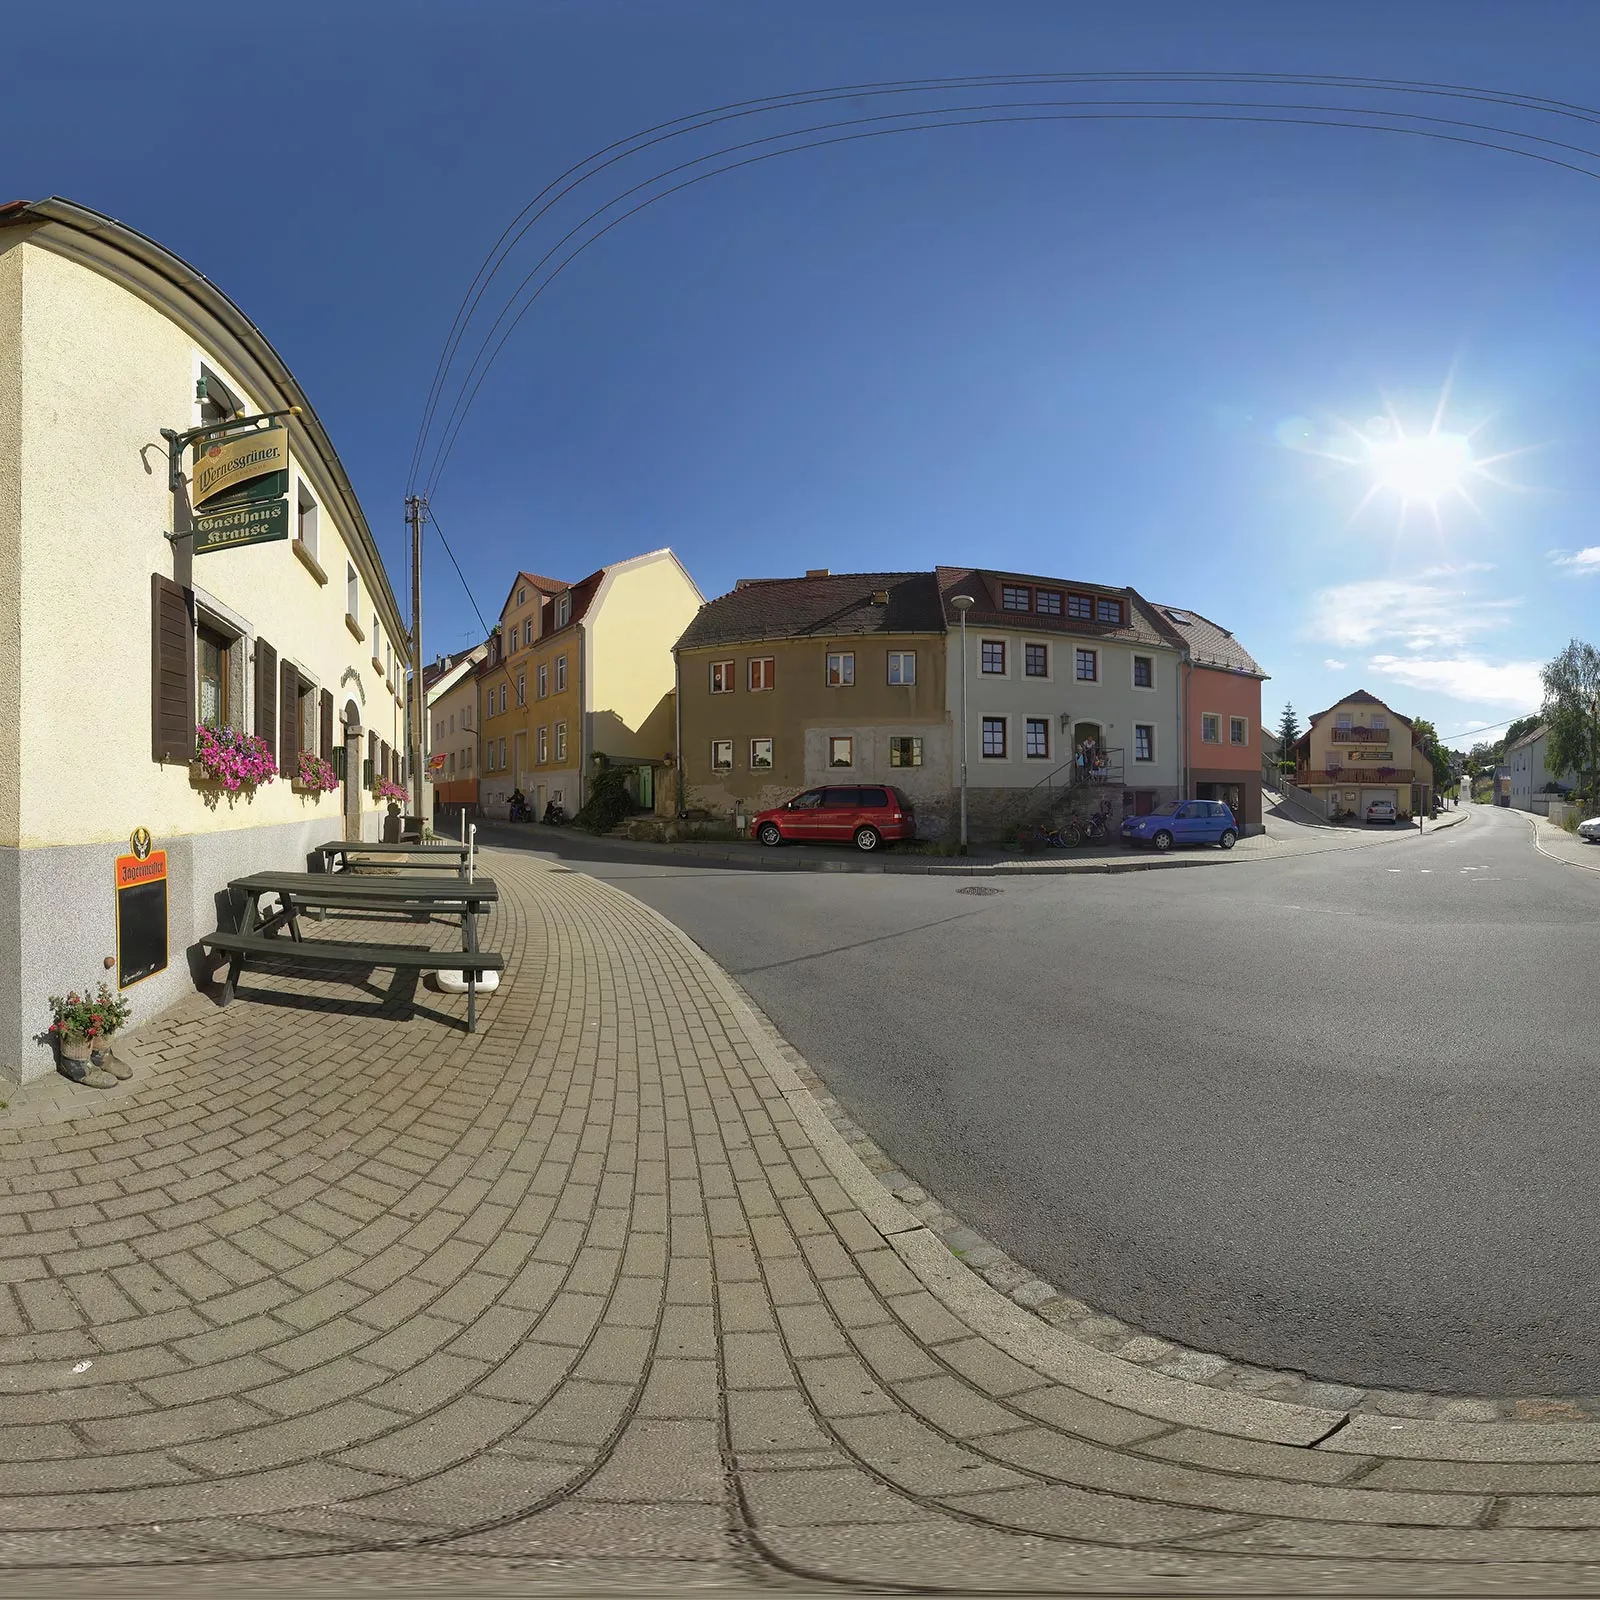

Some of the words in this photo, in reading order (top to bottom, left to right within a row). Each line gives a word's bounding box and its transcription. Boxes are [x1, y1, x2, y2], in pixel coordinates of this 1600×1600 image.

[197, 447, 280, 492] Wernesgrüner
[198, 506, 281, 532] Gasthaus
[208, 523, 270, 544] Krause
[122, 862, 163, 882] Jägermeister
